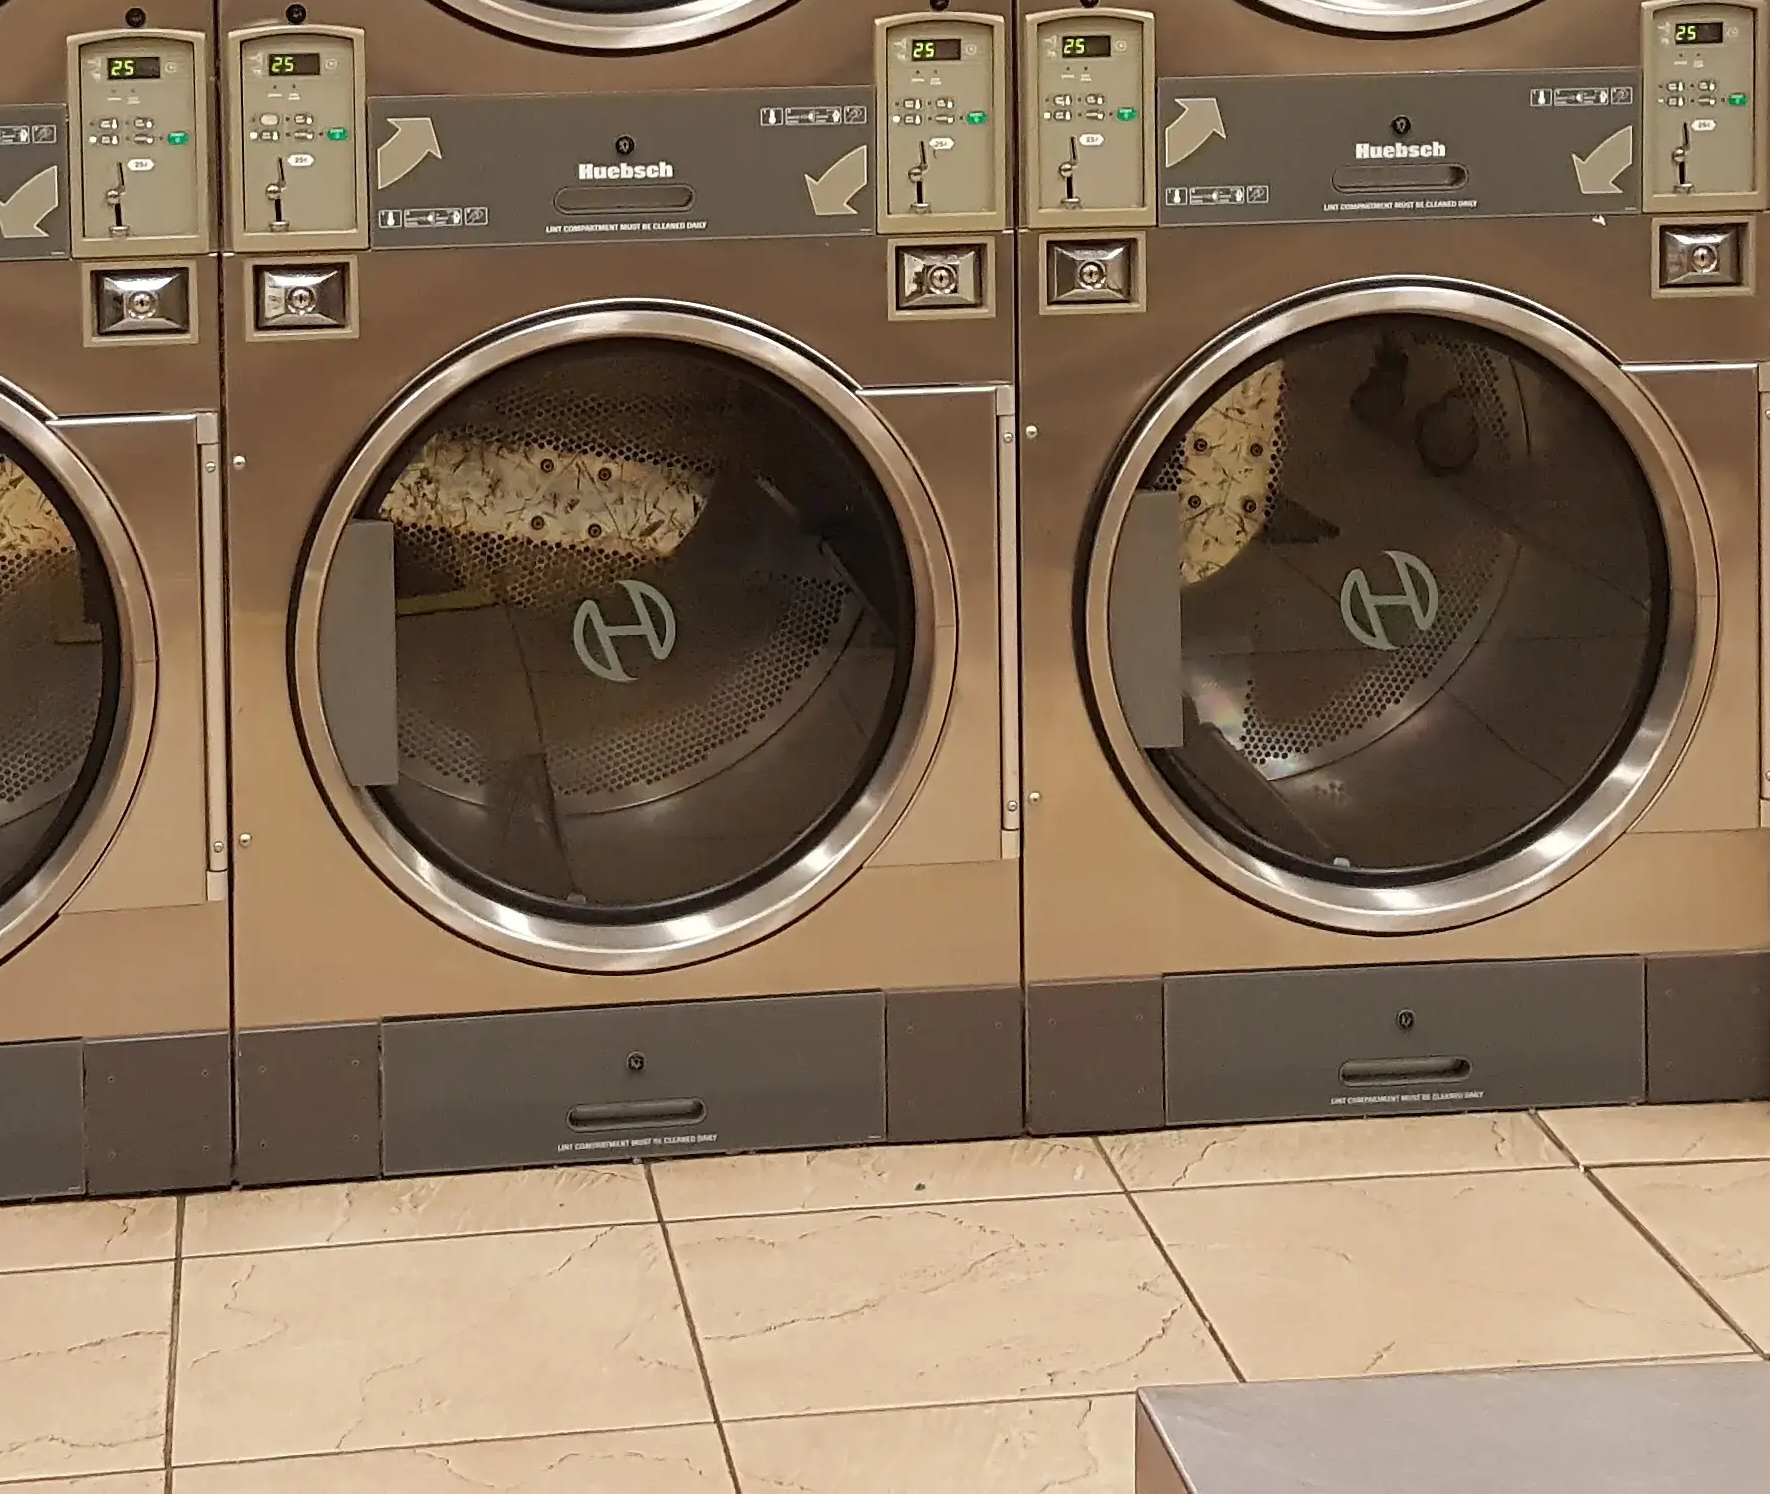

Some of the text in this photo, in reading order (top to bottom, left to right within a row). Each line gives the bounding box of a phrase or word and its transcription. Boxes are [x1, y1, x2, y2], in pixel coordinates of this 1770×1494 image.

[1675, 25, 1696, 41] 25
[111, 60, 134, 76] 25
[1355, 141, 1446, 159] Huebsch
[578, 162, 673, 180] Huebsch
